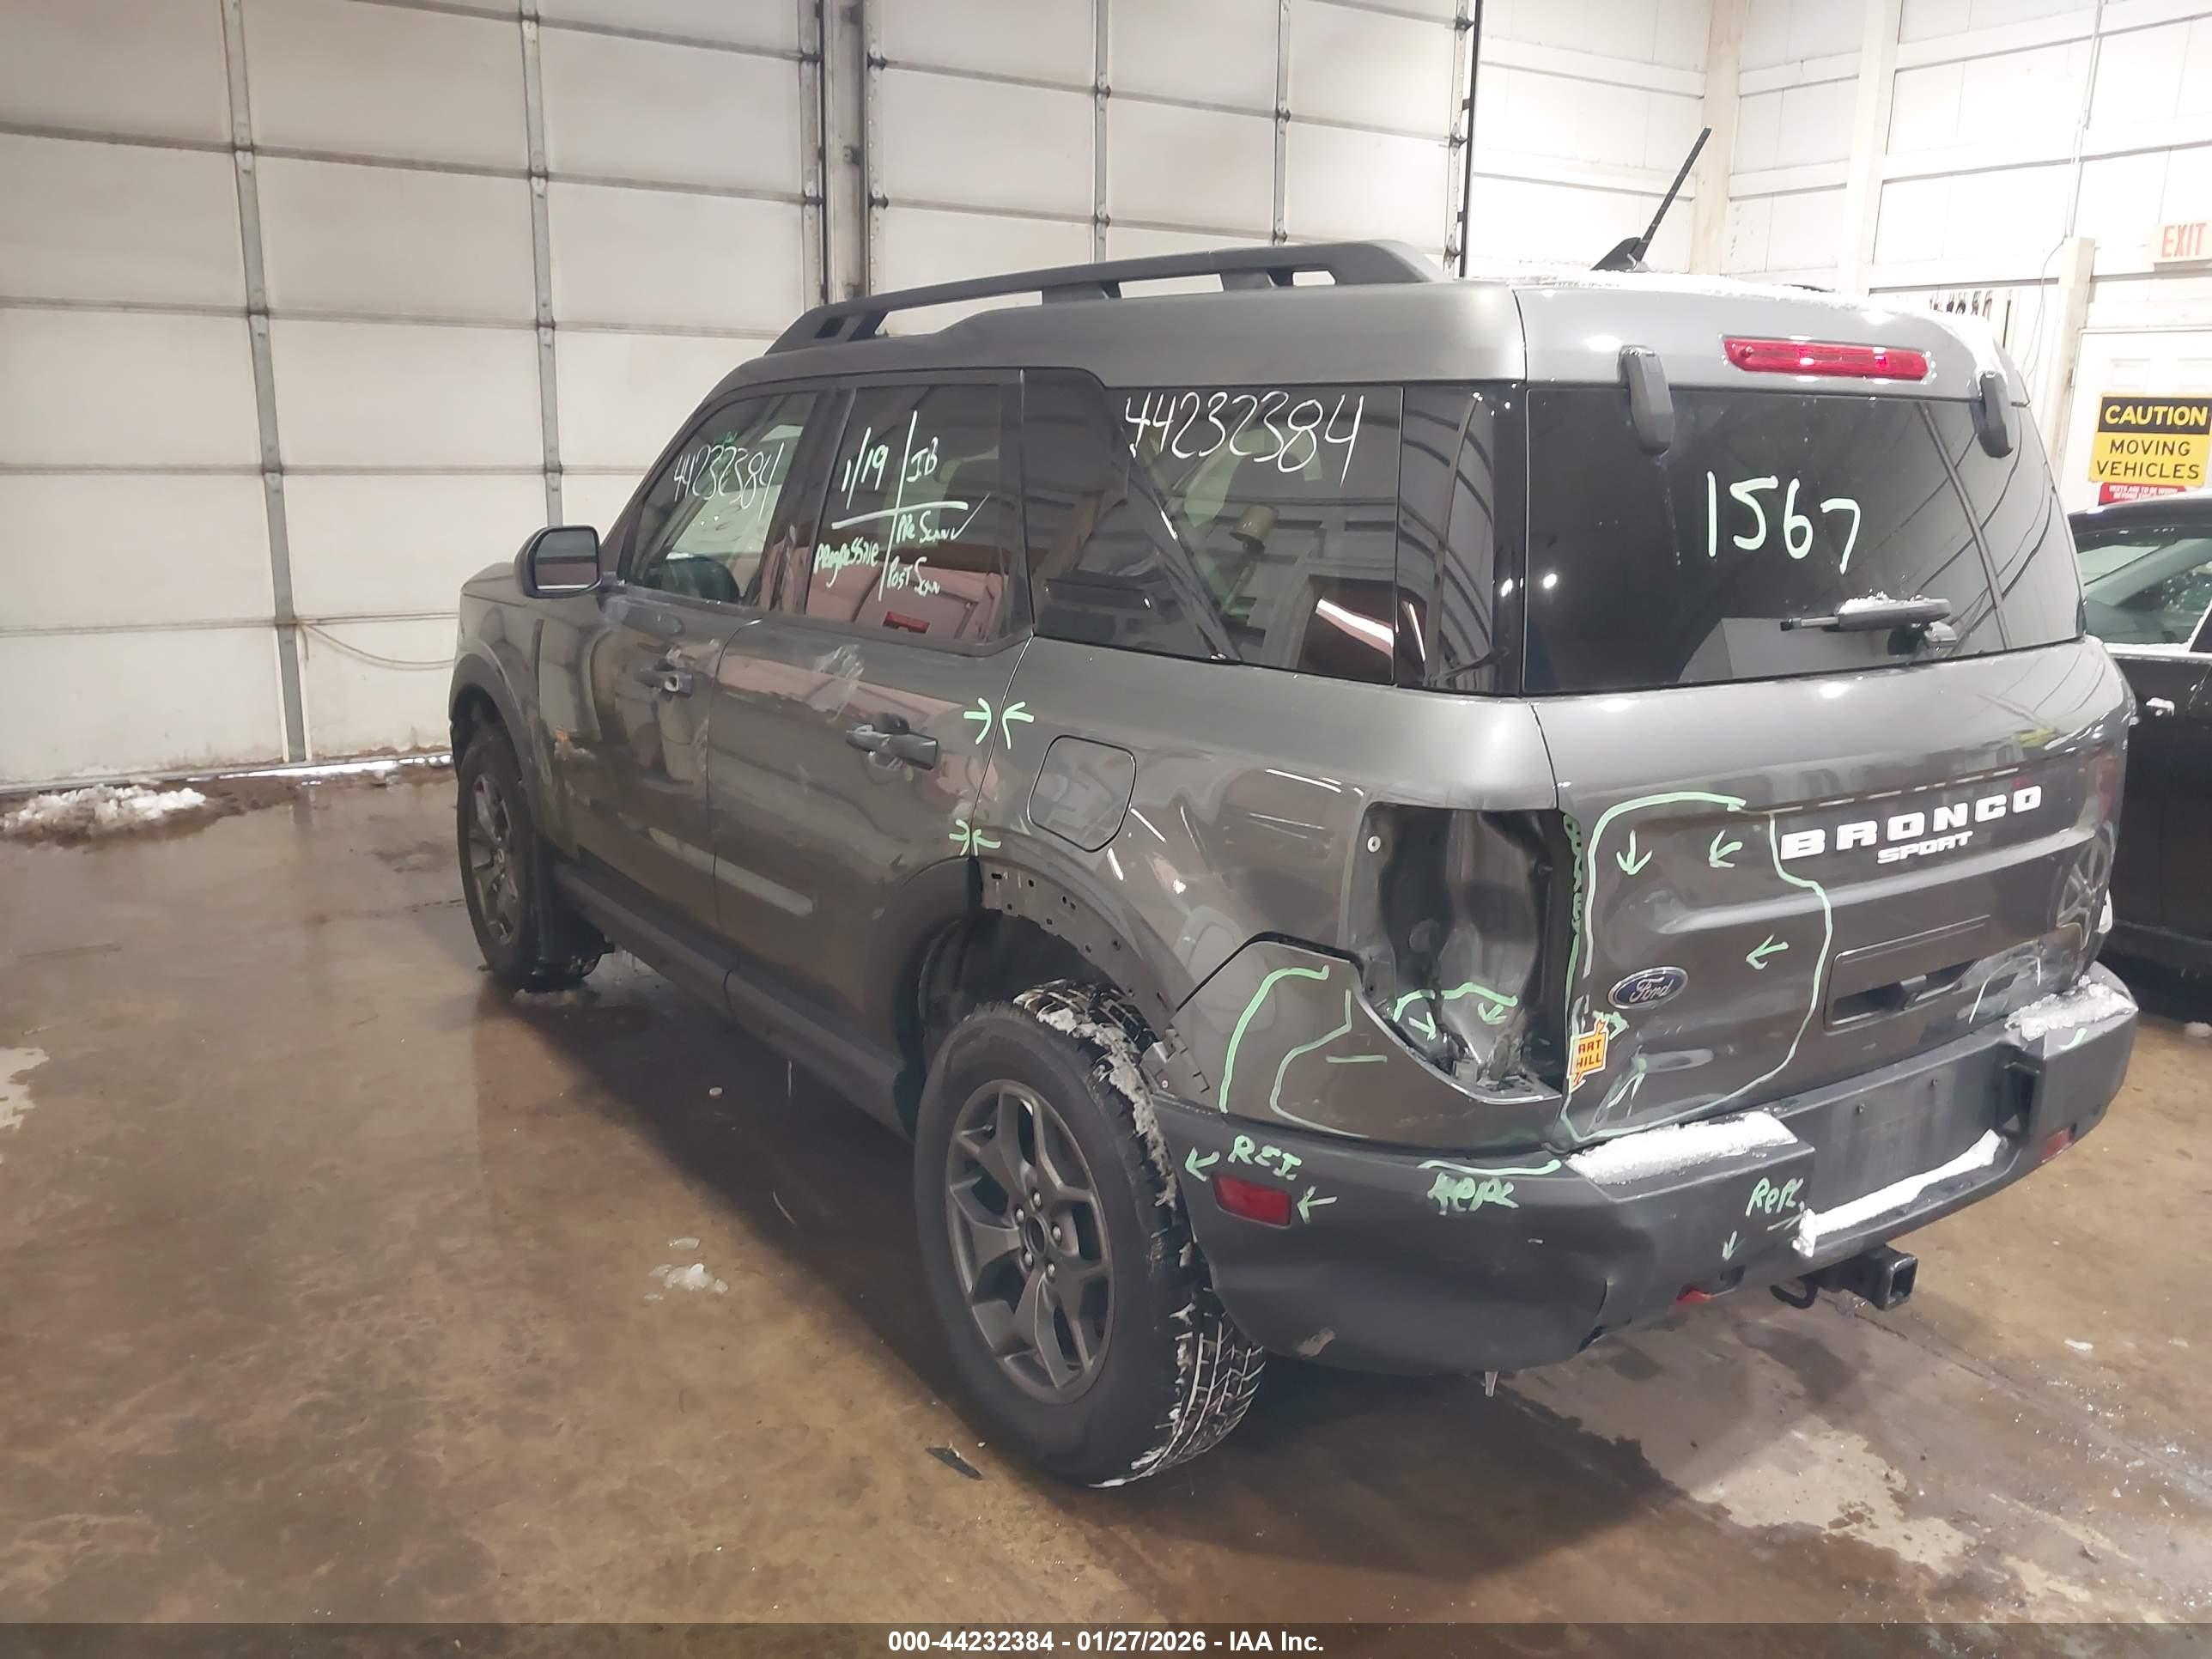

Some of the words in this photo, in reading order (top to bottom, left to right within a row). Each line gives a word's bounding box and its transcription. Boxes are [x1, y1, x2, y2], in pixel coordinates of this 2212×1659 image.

[2160, 222, 2207, 258] EXIT
[2104, 404, 2209, 426] CAUTION
[1124, 391, 1364, 488] 44232384
[2109, 439, 2191, 457] MOVING
[2096, 459, 2201, 479] VEHICLES
[1706, 471, 1862, 574] 1567
[1779, 785, 2043, 860] BRONCO
[1877, 830, 1974, 864] SPORT
[1629, 975, 1675, 1002] Ford
